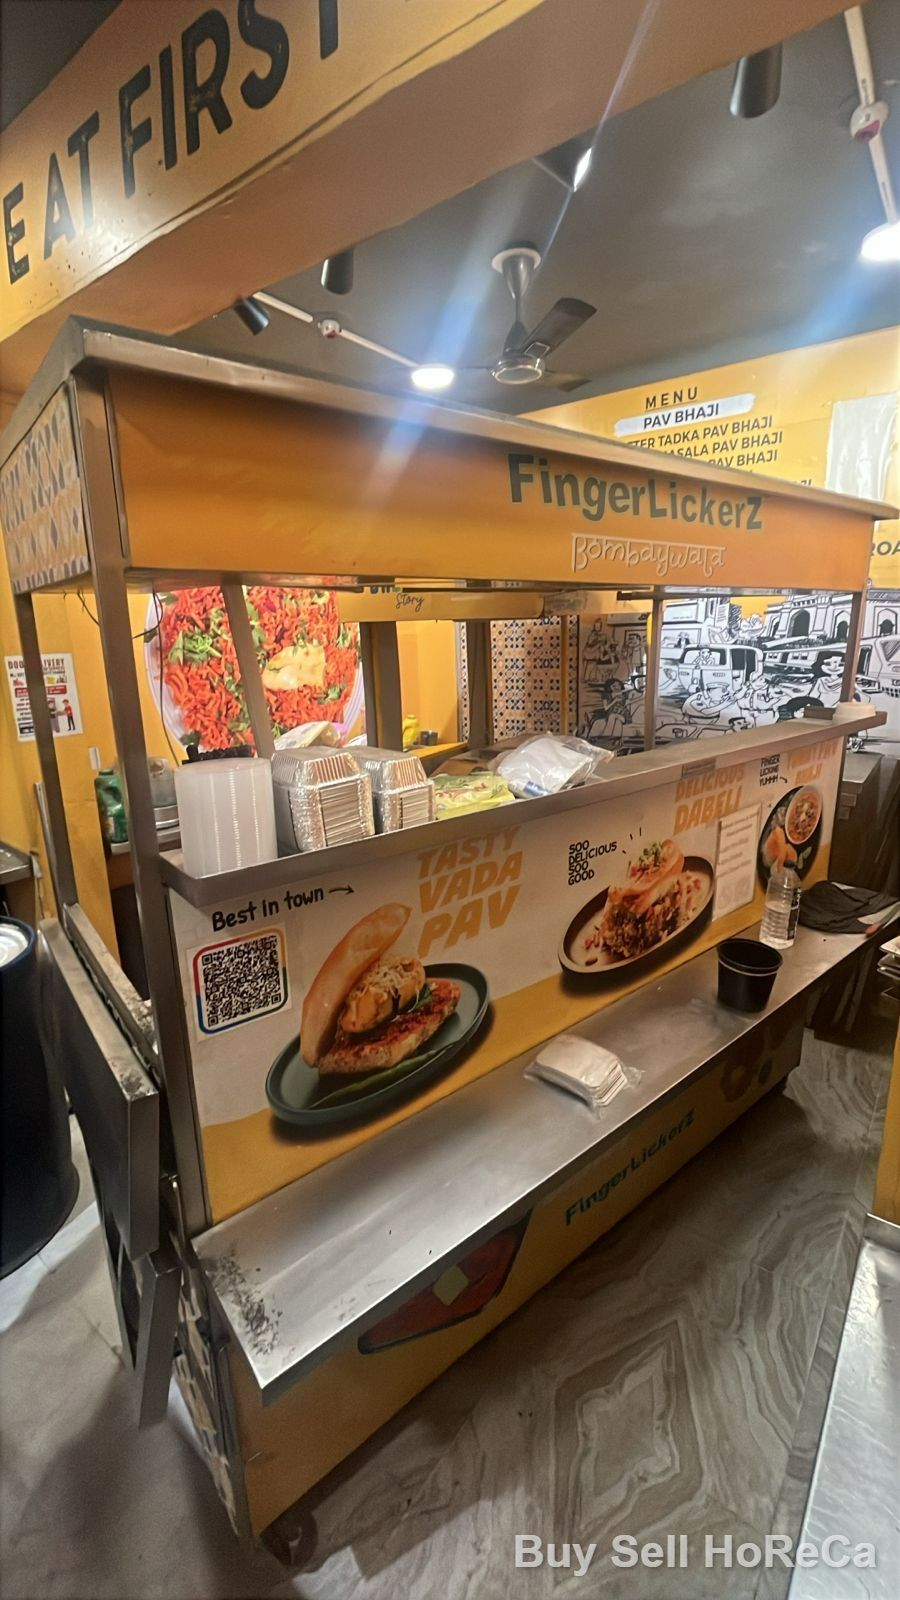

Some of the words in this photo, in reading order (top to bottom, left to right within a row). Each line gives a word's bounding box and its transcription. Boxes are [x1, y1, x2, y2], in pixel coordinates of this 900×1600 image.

[645, 386, 699, 410] MENU
[644, 412, 671, 429] PAV
[675, 403, 719, 423] BHAJI
[658, 430, 699, 447] TADKA
[703, 424, 729, 439] PAV
[732, 415, 773, 434] BHAJI
[712, 438, 738, 454] PAV
[741, 431, 783, 449] BHAJI
[737, 449, 778, 467] BHAJI
[508, 453, 763, 530] FingerLickerZ
[571, 533, 727, 577] Bombaywala
[395, 593, 423, 612] Story
[673, 785, 742, 836] DABELI
[417, 826, 521, 880] TASTY
[569, 840, 589, 855] SOO
[569, 841, 617, 865] DELICIOUS
[568, 861, 589, 875] SOO
[568, 869, 595, 886] GOOD
[419, 850, 523, 914] VADA
[212, 901, 257, 932] Best
[262, 899, 279, 917] in
[284, 887, 324, 910] town
[417, 884, 522, 959] PAV
